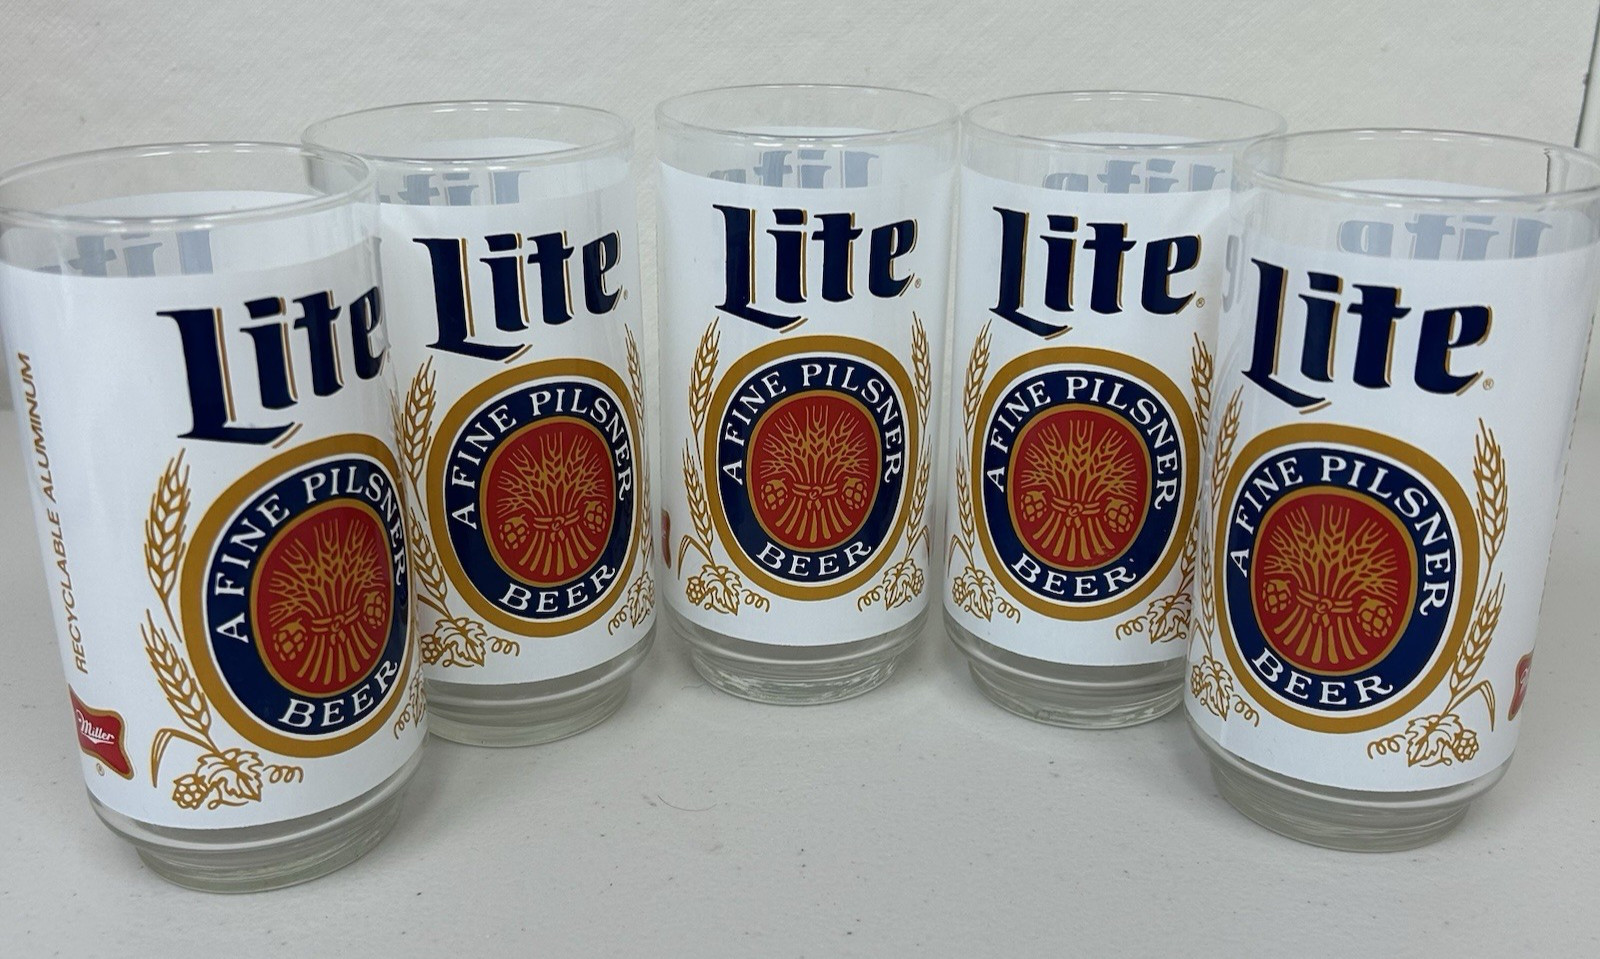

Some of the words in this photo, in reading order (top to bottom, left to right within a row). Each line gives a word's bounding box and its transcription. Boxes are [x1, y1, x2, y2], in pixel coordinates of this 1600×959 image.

[413, 230, 623, 364] Lite
[712, 204, 918, 333] Lite
[989, 206, 1201, 340] Lite
[157, 286, 388, 448] Lite
[1241, 257, 1493, 414] Lite
[18, 352, 57, 505] ALUMINUM
[452, 404, 517, 489] FINE
[529, 388, 633, 501] PILSNER
[724, 371, 787, 447] FINE
[801, 363, 903, 483] PILSNER
[990, 380, 1051, 453] FINE
[1066, 376, 1179, 509] PILSNER
[723, 459, 743, 485] A
[987, 466, 1005, 492] A
[1235, 457, 1303, 535] FINE
[215, 494, 290, 596] FINE
[304, 466, 407, 586] PILSNER
[451, 502, 477, 529] A
[1319, 455, 1451, 616] PILSNER
[47, 508, 88, 675] RECYCLABLE
[499, 564, 616, 613] BEER
[756, 541, 872, 577] BEER
[1010, 553, 1136, 597] BEER
[1230, 549, 1249, 577] A
[217, 612, 249, 643] A
[279, 659, 399, 729] BEER
[1251, 647, 1393, 705] BEER
[76, 709, 115, 742] Miller
